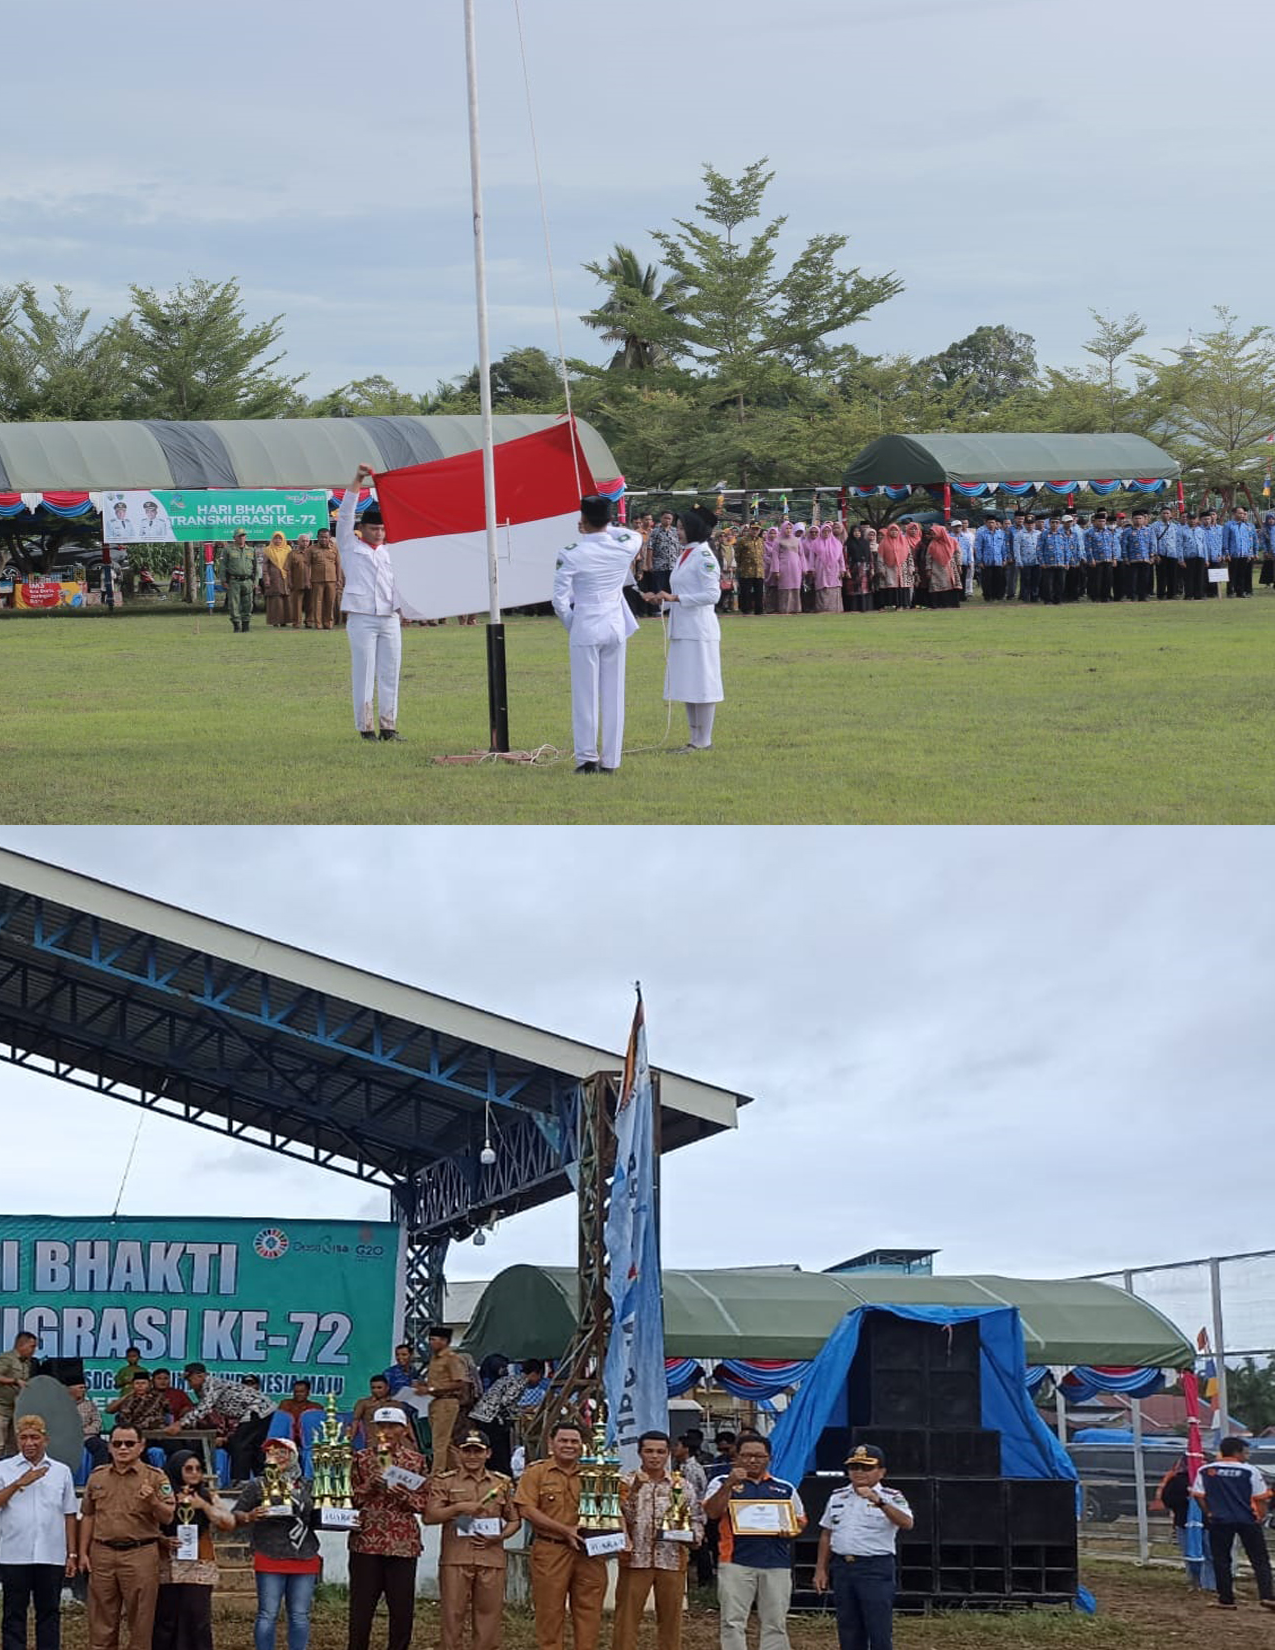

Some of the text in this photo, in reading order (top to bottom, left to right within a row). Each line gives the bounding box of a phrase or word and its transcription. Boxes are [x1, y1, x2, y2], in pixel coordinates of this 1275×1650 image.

[197, 504, 287, 515] HARI BHAKTI
[171, 515, 316, 526] TRANSMIGRASI KE-72
[356, 1244, 384, 1256] G20
[34, 1239, 239, 1296] BHAKTI
[200, 1308, 354, 1365] KE-72
